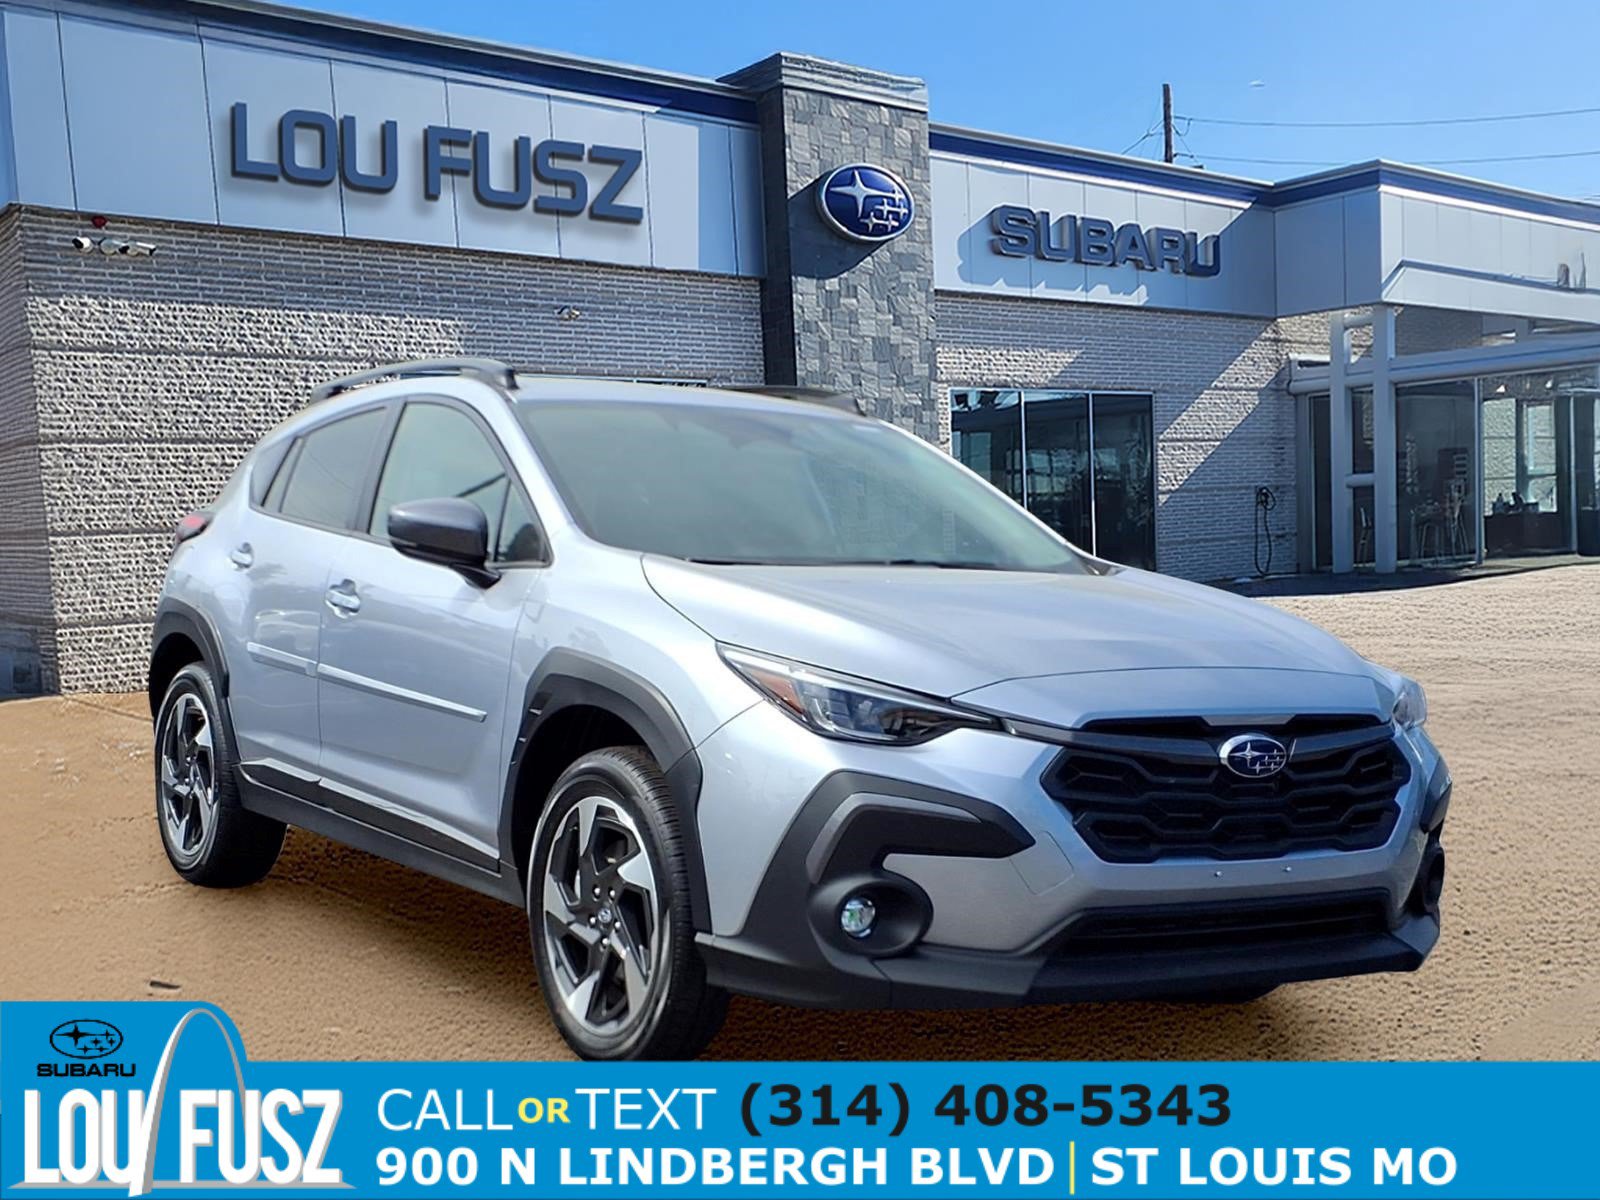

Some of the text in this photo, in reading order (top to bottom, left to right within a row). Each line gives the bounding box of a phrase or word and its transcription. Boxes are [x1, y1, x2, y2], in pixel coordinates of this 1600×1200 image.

[231, 102, 643, 223] LOU FUSZ
[991, 204, 1221, 277] SUBARU
